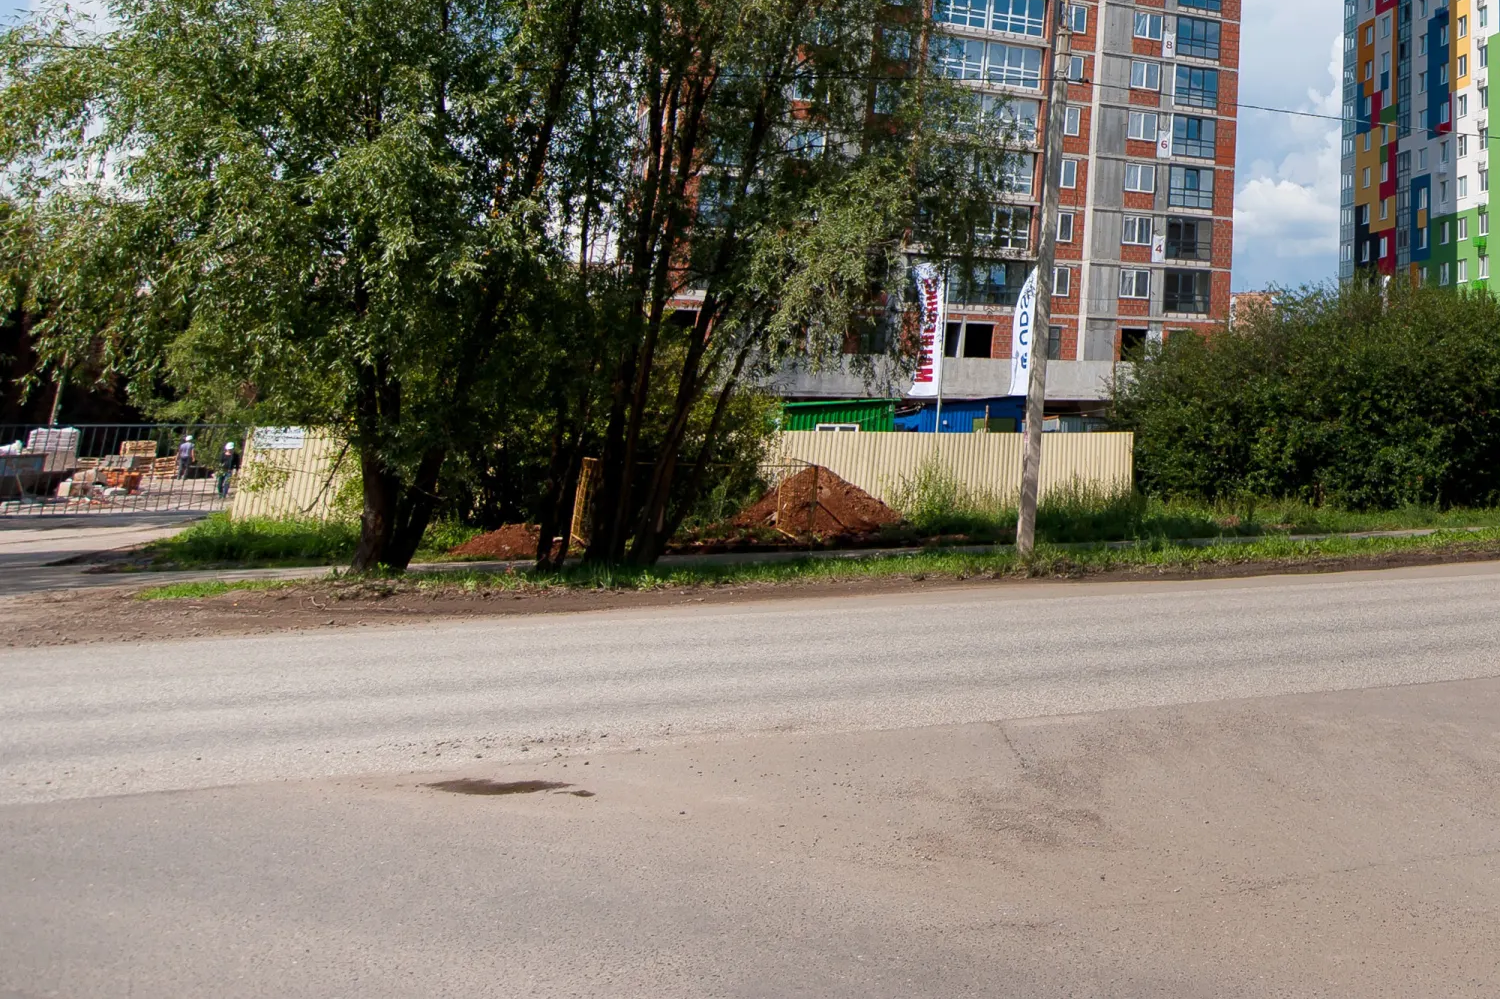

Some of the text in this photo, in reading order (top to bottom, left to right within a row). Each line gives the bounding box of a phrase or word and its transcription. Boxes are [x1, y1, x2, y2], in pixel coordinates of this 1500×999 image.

[1166, 40, 1173, 49] 8
[1161, 140, 1168, 149] 6
[1155, 244, 1162, 253] 4
